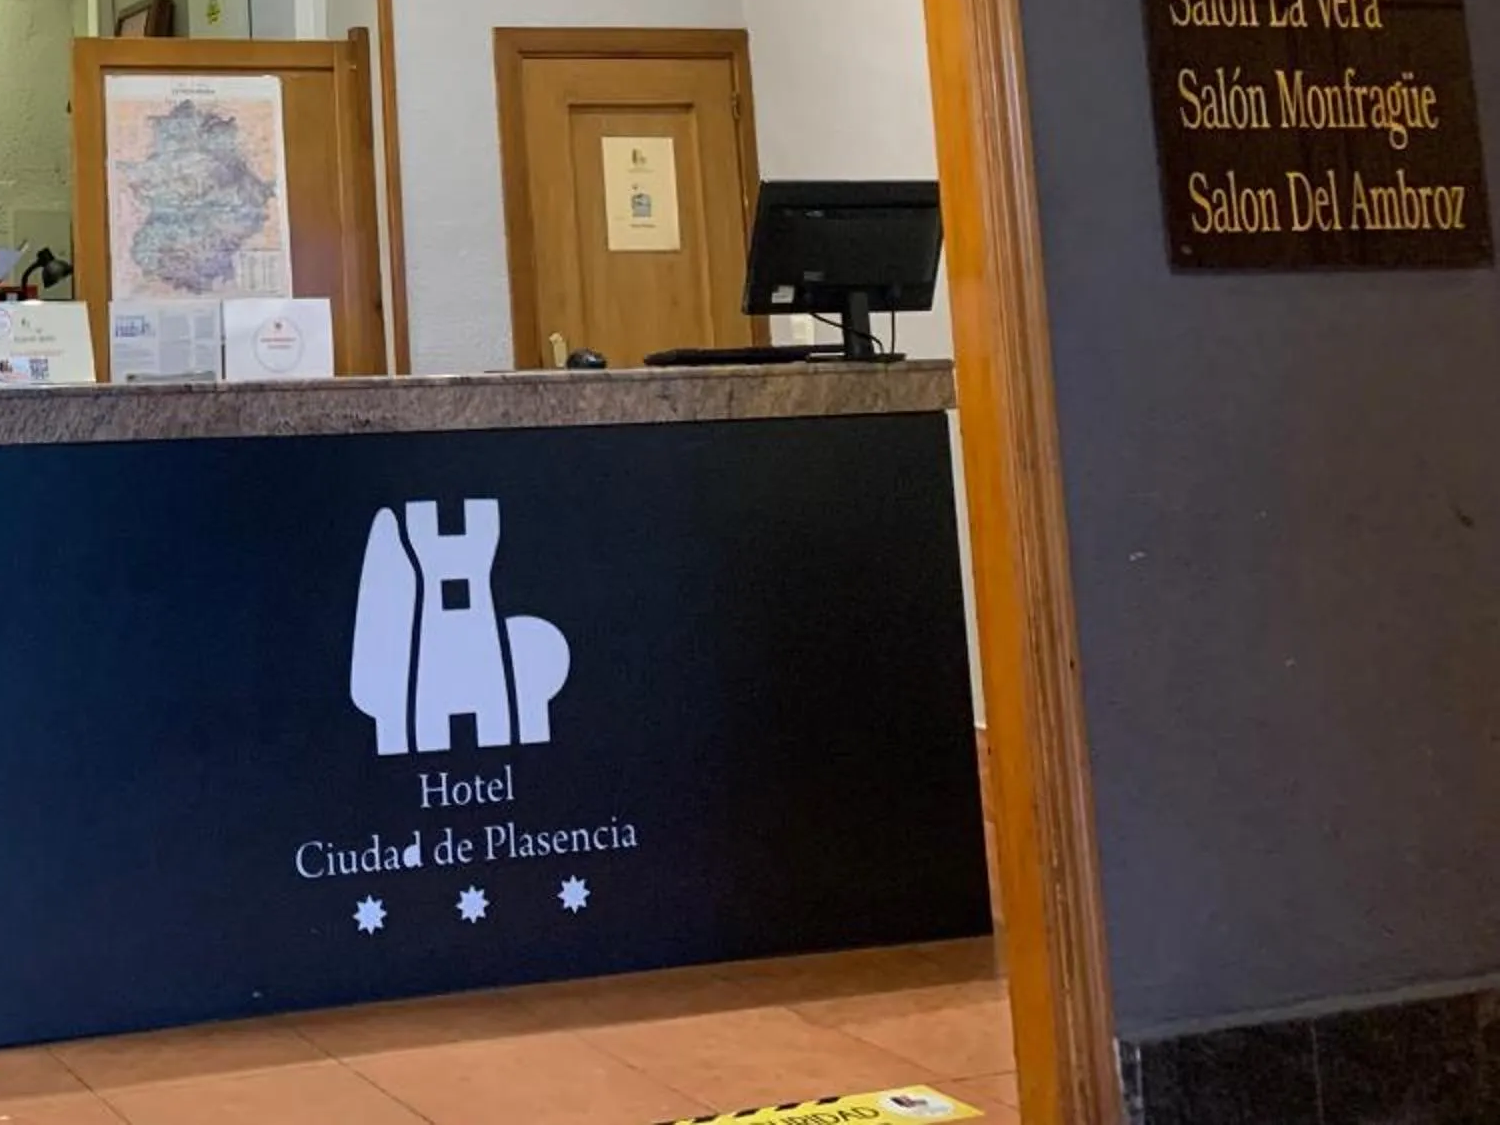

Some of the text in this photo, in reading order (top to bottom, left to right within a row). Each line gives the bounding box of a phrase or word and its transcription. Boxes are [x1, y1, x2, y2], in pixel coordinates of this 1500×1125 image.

[1178, 67, 1438, 151] Salón Monfragüe
[1188, 168, 1466, 233] Salon Del Ambroz
[418, 764, 515, 808] Hotel
[295, 816, 638, 879] Ciudad de Plasencia
